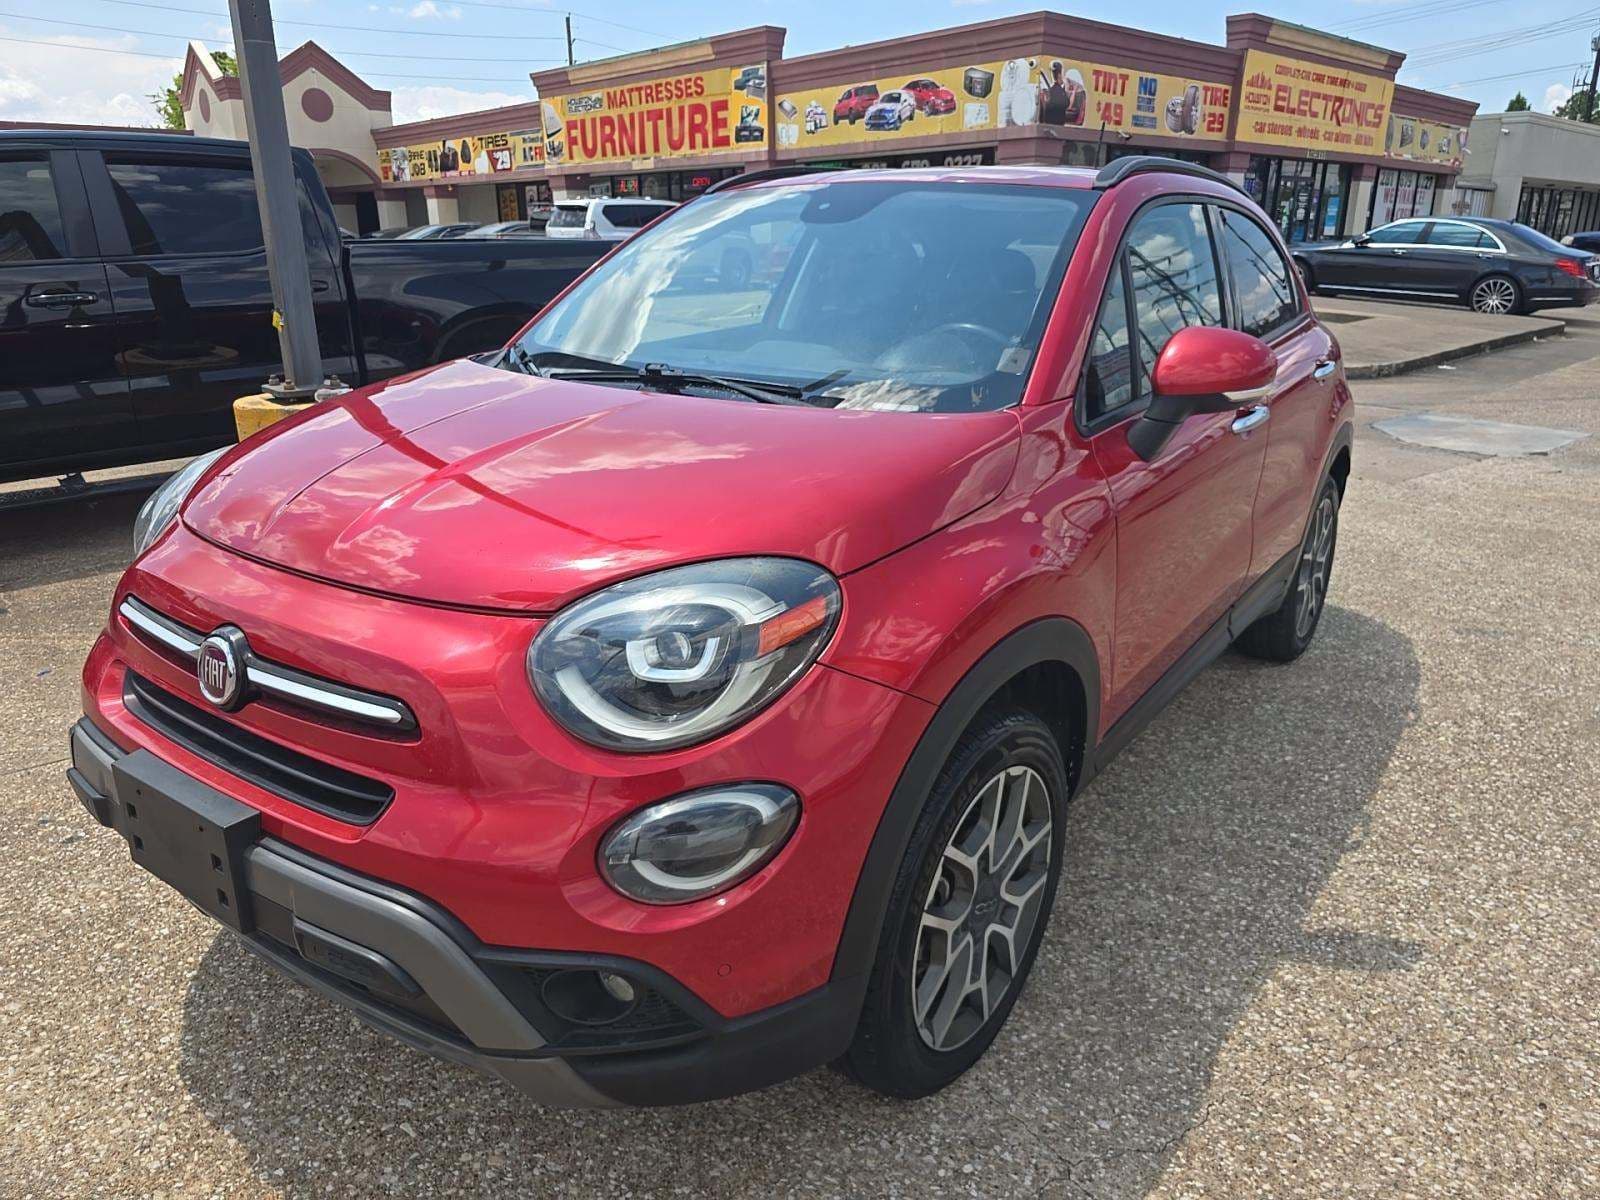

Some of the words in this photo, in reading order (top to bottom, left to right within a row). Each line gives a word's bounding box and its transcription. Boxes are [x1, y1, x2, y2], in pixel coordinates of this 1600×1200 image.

[606, 76, 705, 110] MATTRESSES
[1092, 69, 1129, 97] TINT
[1138, 76, 1158, 97] NO
[1202, 85, 1230, 108] TIRE
[1273, 84, 1386, 129] ELECTRONICS
[477, 134, 509, 151] TIRES
[565, 99, 732, 161] FURNITURE
[204, 655, 226, 690] FIAT
